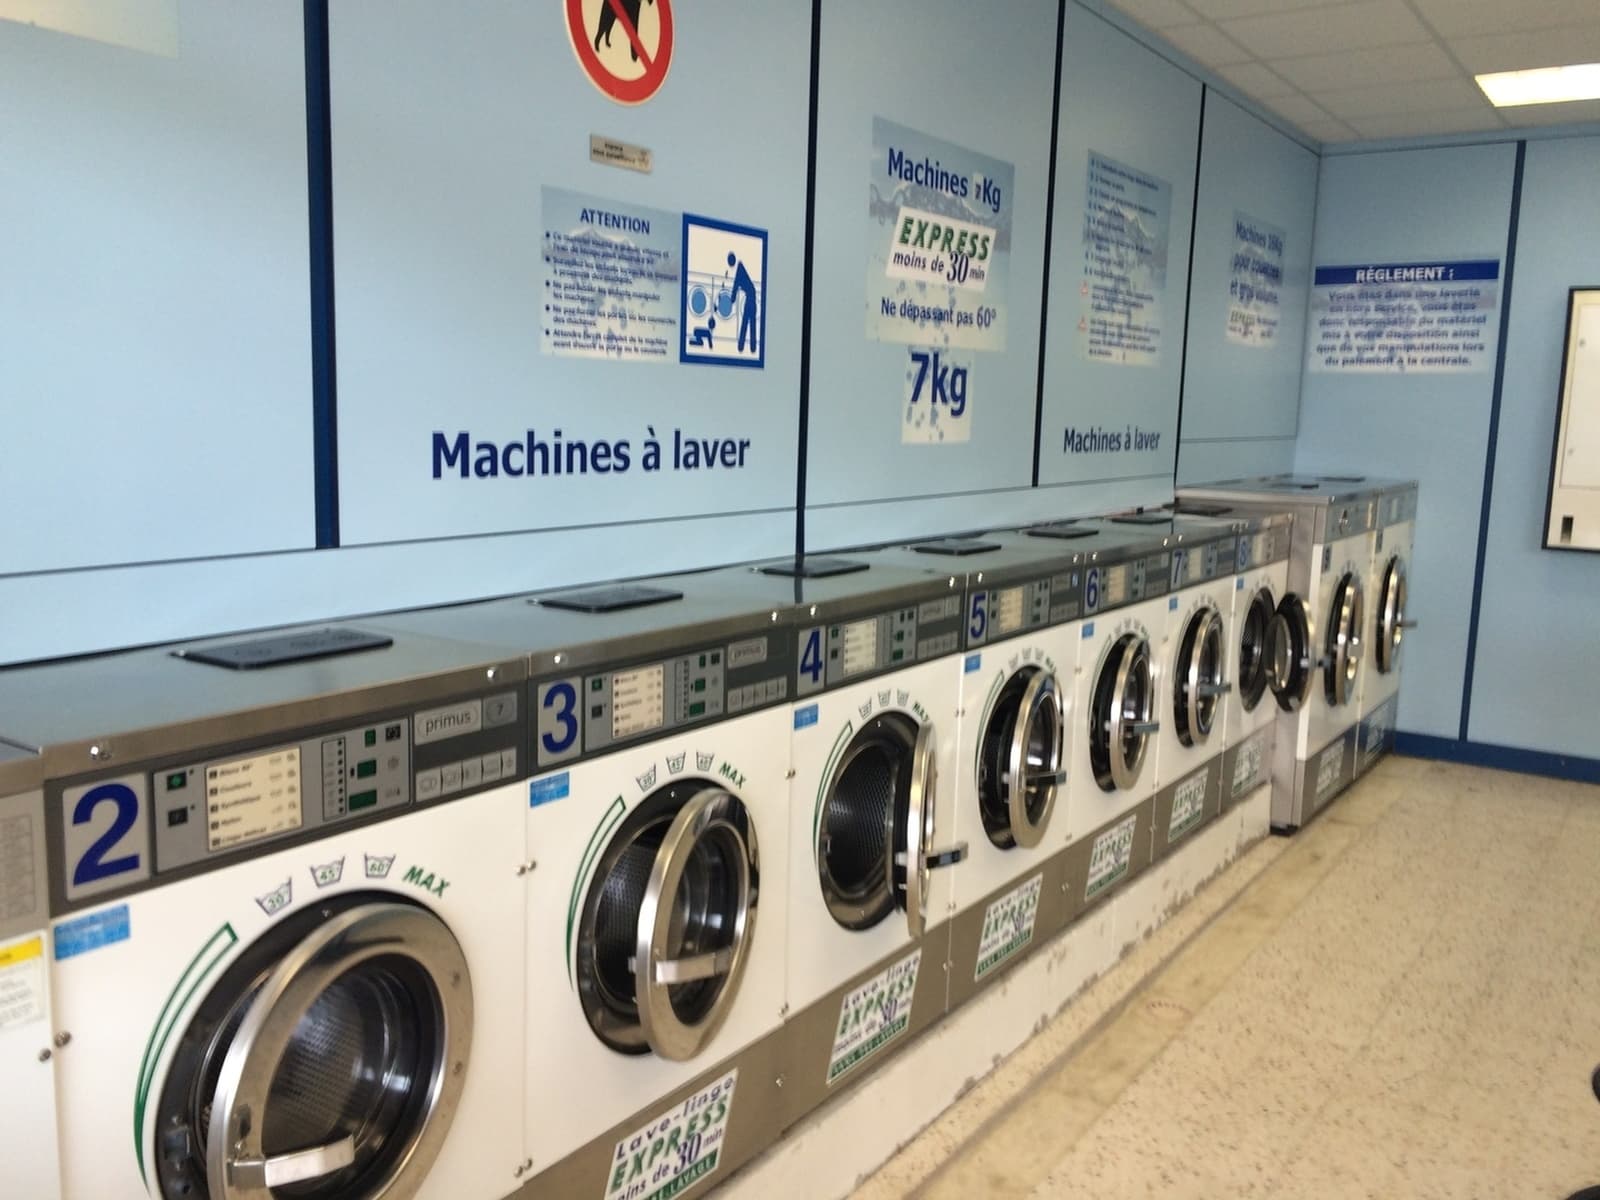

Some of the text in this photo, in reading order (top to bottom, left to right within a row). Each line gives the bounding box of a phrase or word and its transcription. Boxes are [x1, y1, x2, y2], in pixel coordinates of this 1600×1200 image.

[888, 147, 968, 197] Machines
[580, 207, 650, 235] ATTENTION
[899, 216, 990, 261] EXPRESS
[893, 251, 985, 283] moins de 30 min
[881, 297, 896, 317] Ne
[900, 298, 953, 324] dépassant
[957, 310, 974, 328] pas
[911, 352, 968, 418] 7kg
[432, 425, 750, 480] Machines à laver
[1063, 424, 1160, 454] Machines à laver
[1086, 568, 1098, 608] 6
[1174, 552, 1183, 585] 7
[970, 592, 986, 639] 5
[800, 628, 823, 684] 4
[426, 710, 471, 737] primus
[542, 681, 578, 756] 3
[719, 762, 746, 790] MAX
[72, 783, 140, 886] 2
[402, 865, 450, 899] MAX
[616, 1077, 734, 1160] Lave-linge
[609, 1095, 728, 1194] EXPRESS
[652, 1162, 670, 1185] de
[673, 1132, 702, 1175] 30
